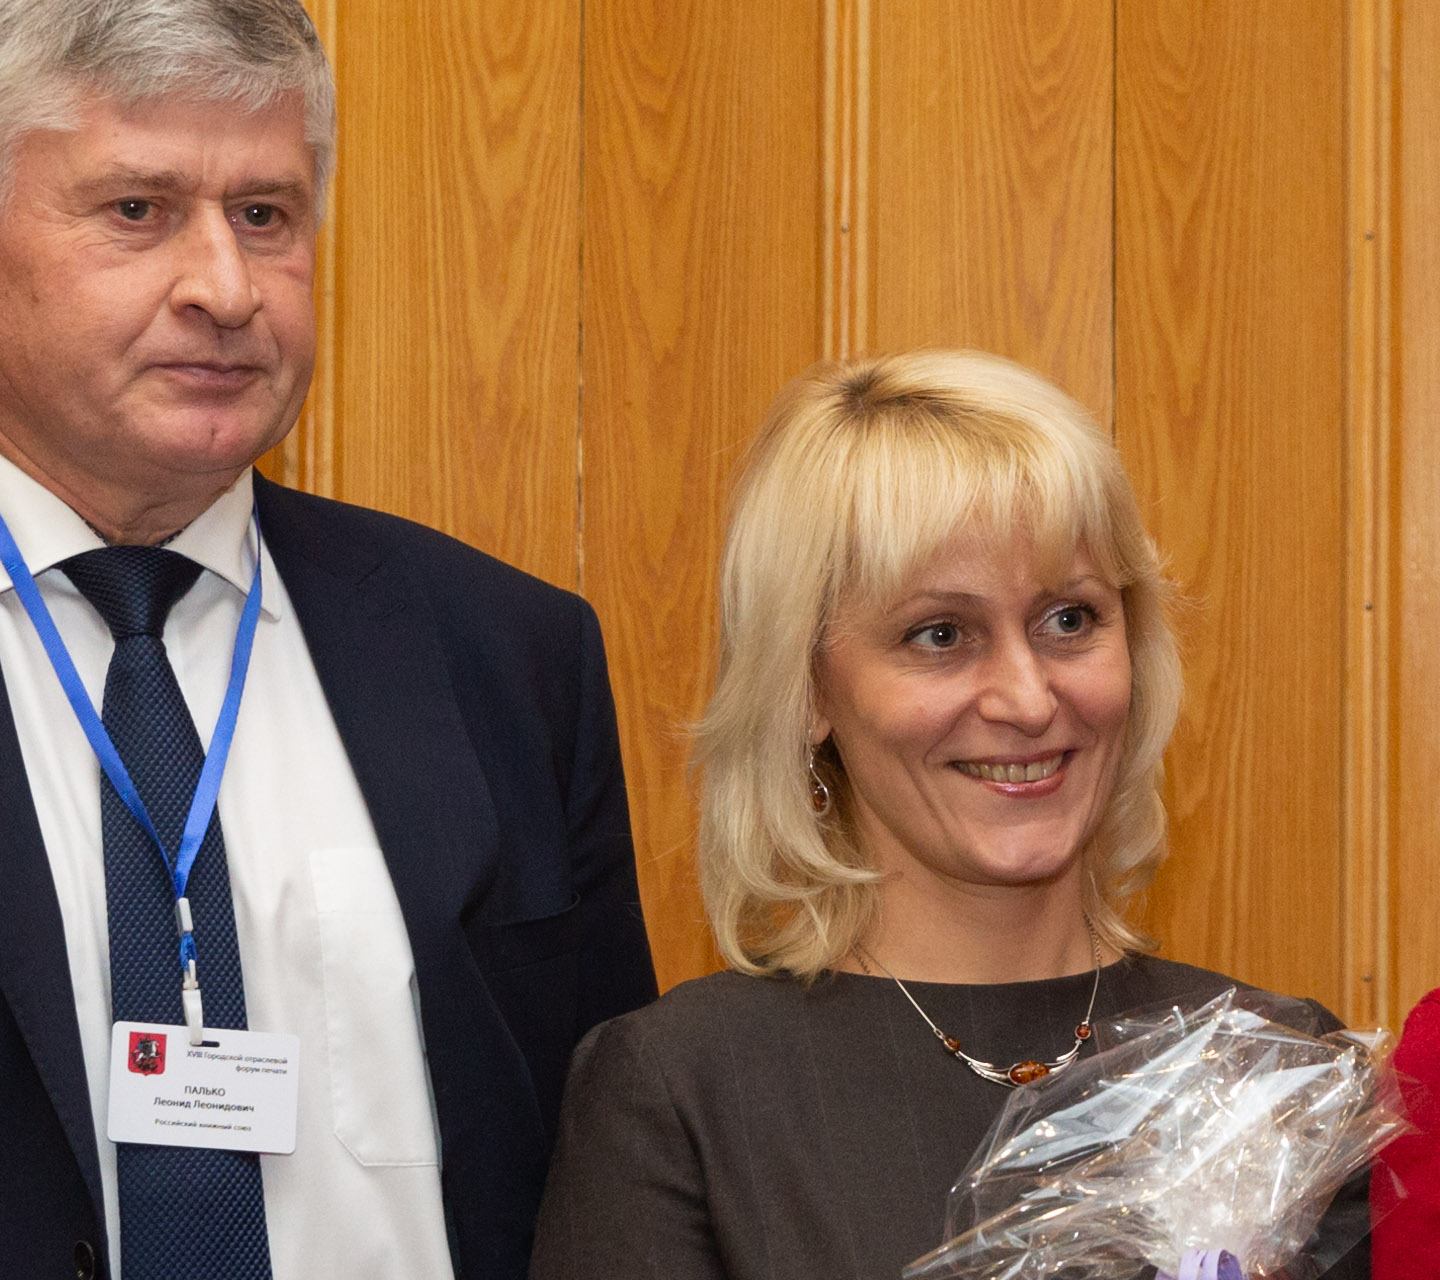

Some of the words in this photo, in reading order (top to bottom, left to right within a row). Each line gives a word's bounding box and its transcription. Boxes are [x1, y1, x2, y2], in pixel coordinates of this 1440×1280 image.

[184, 1085, 226, 1097] ПАЛЬКО
[153, 1096, 191, 1109] Леонид
[193, 1099, 255, 1112] Леонидович
